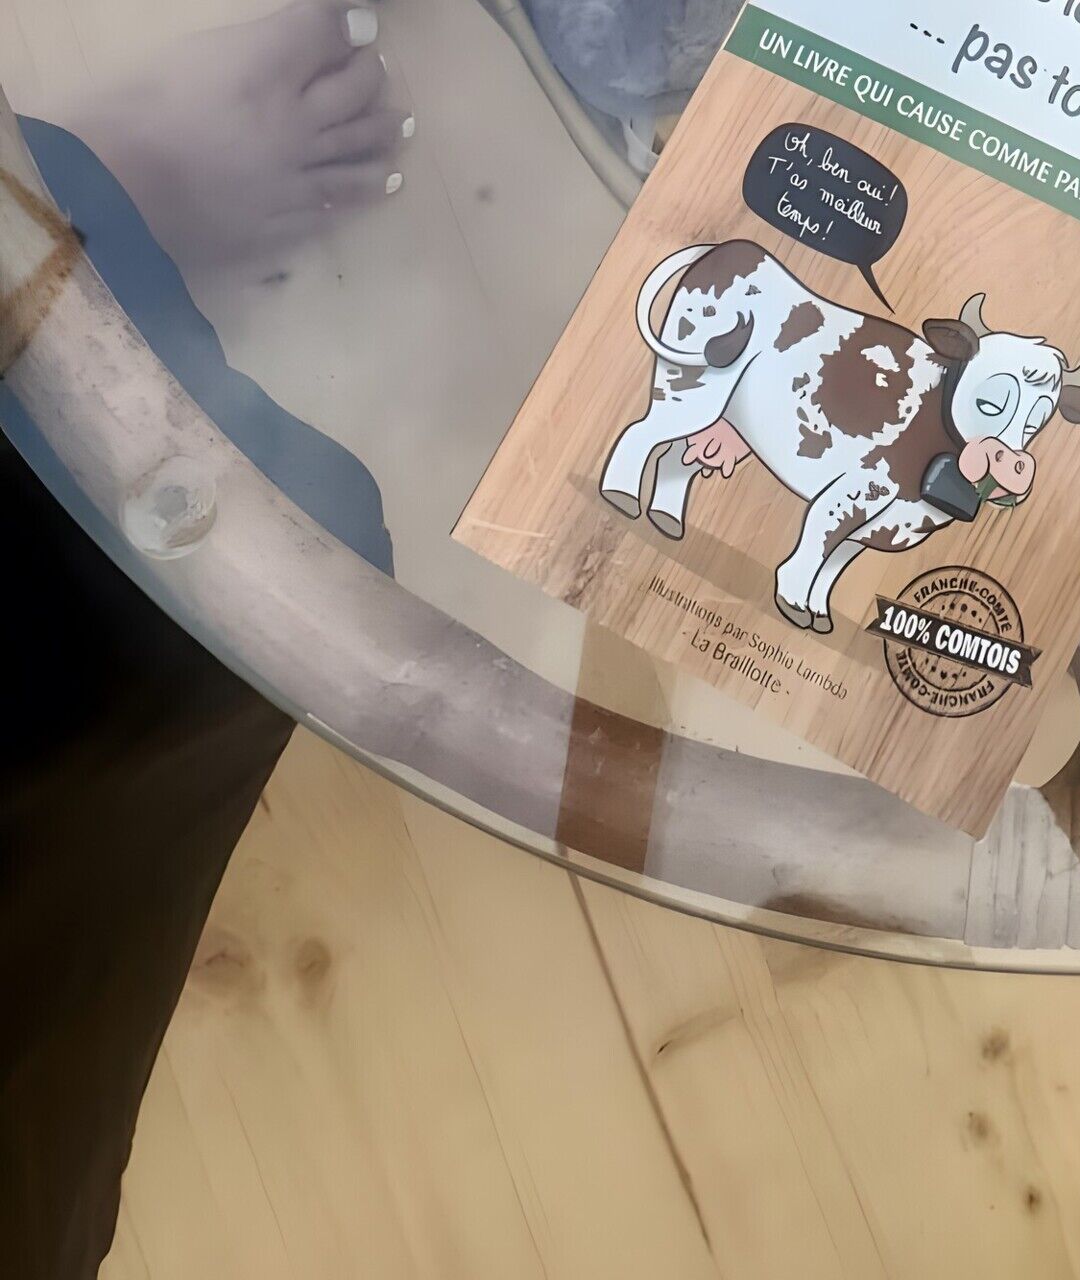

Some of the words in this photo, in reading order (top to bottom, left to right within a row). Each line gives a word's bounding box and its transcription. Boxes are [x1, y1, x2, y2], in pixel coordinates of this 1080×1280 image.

[951, 23, 1038, 90] pas
[759, 28, 793, 59] UN
[792, 45, 853, 87] LIVRE
[853, 74, 895, 107] QUI
[896, 95, 967, 141] CAUSE
[968, 128, 1053, 184] COMME
[768, 156, 808, 190] T'as
[818, 147, 851, 184] ben
[691, 628, 709, 653] La
[722, 620, 749, 642] par
[879, 605, 932, 645] 100%
[935, 624, 1021, 674] COMTOIS
